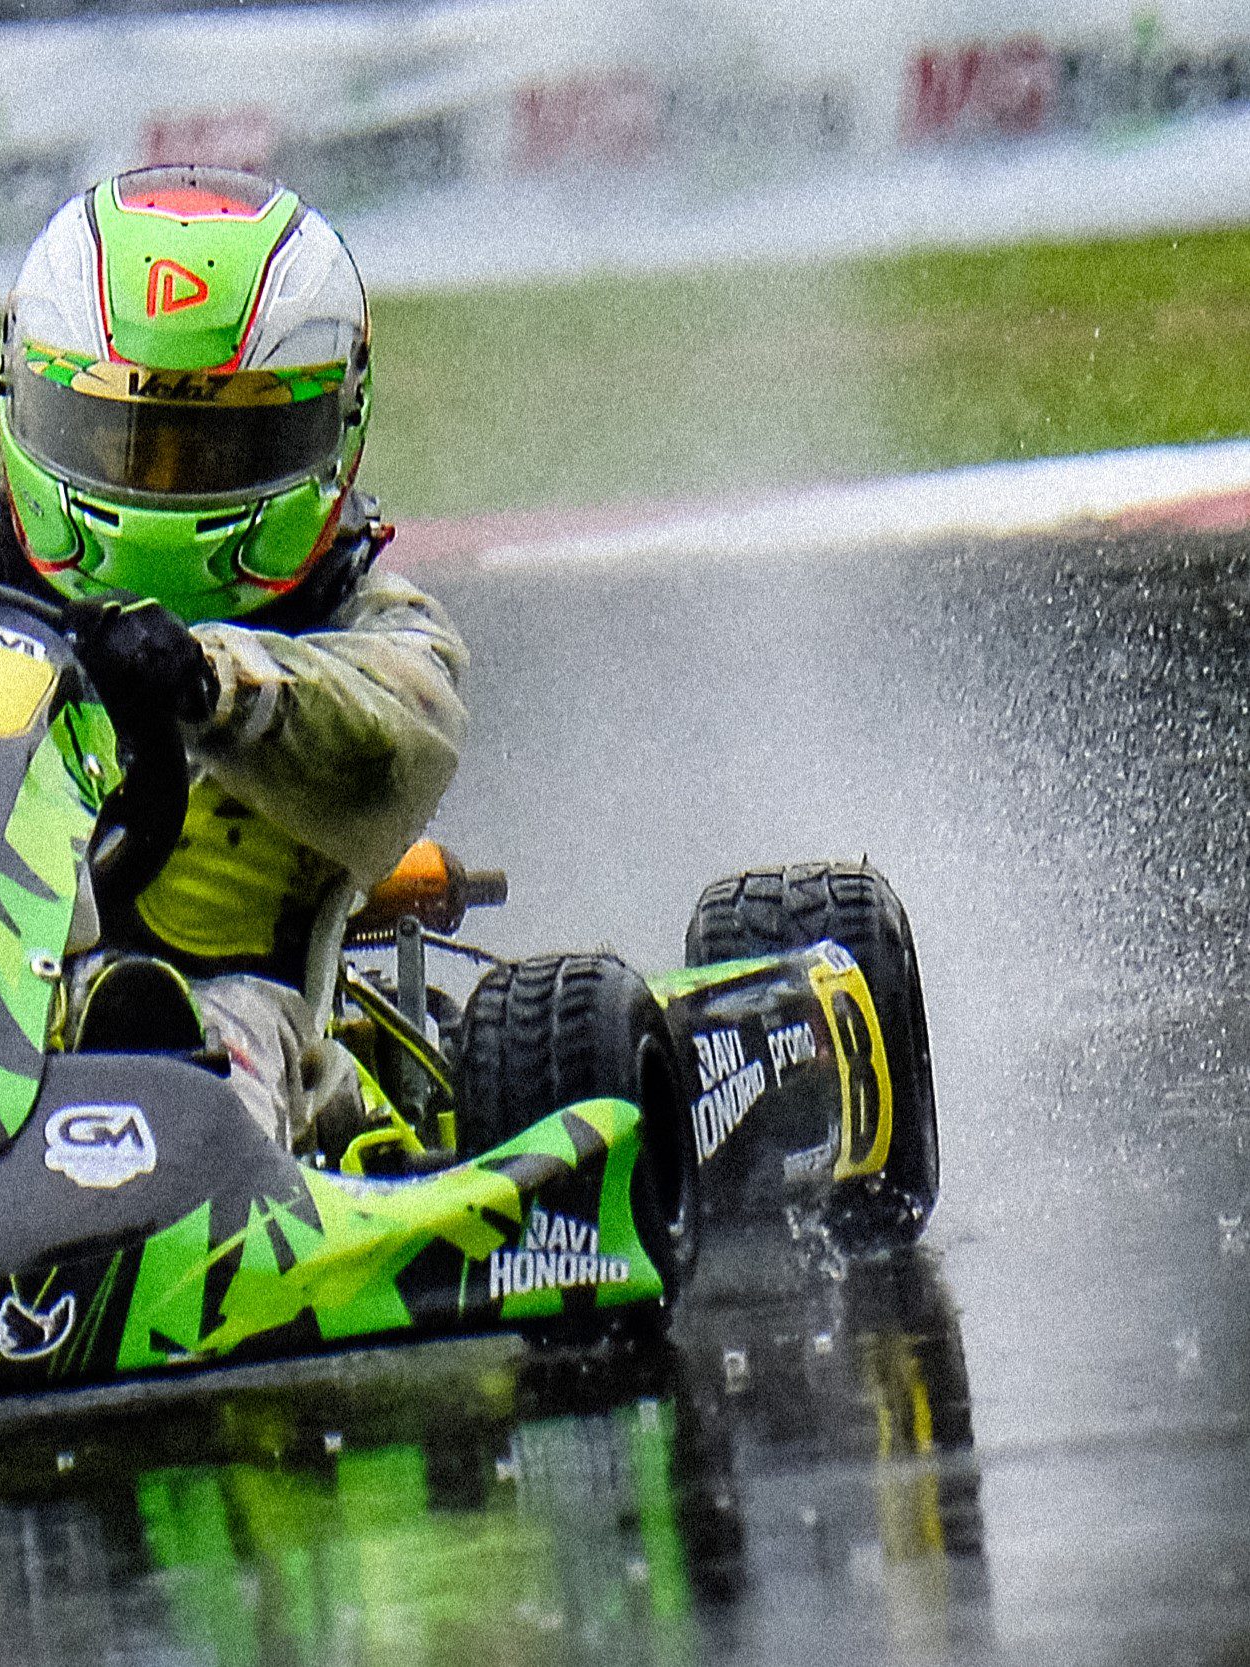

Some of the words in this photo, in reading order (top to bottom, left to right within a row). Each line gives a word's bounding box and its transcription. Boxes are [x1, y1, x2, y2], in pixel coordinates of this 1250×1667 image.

[831, 990, 881, 1165] 8
[57, 1114, 145, 1153] GM
[489, 1250, 630, 1300] HONORIO
